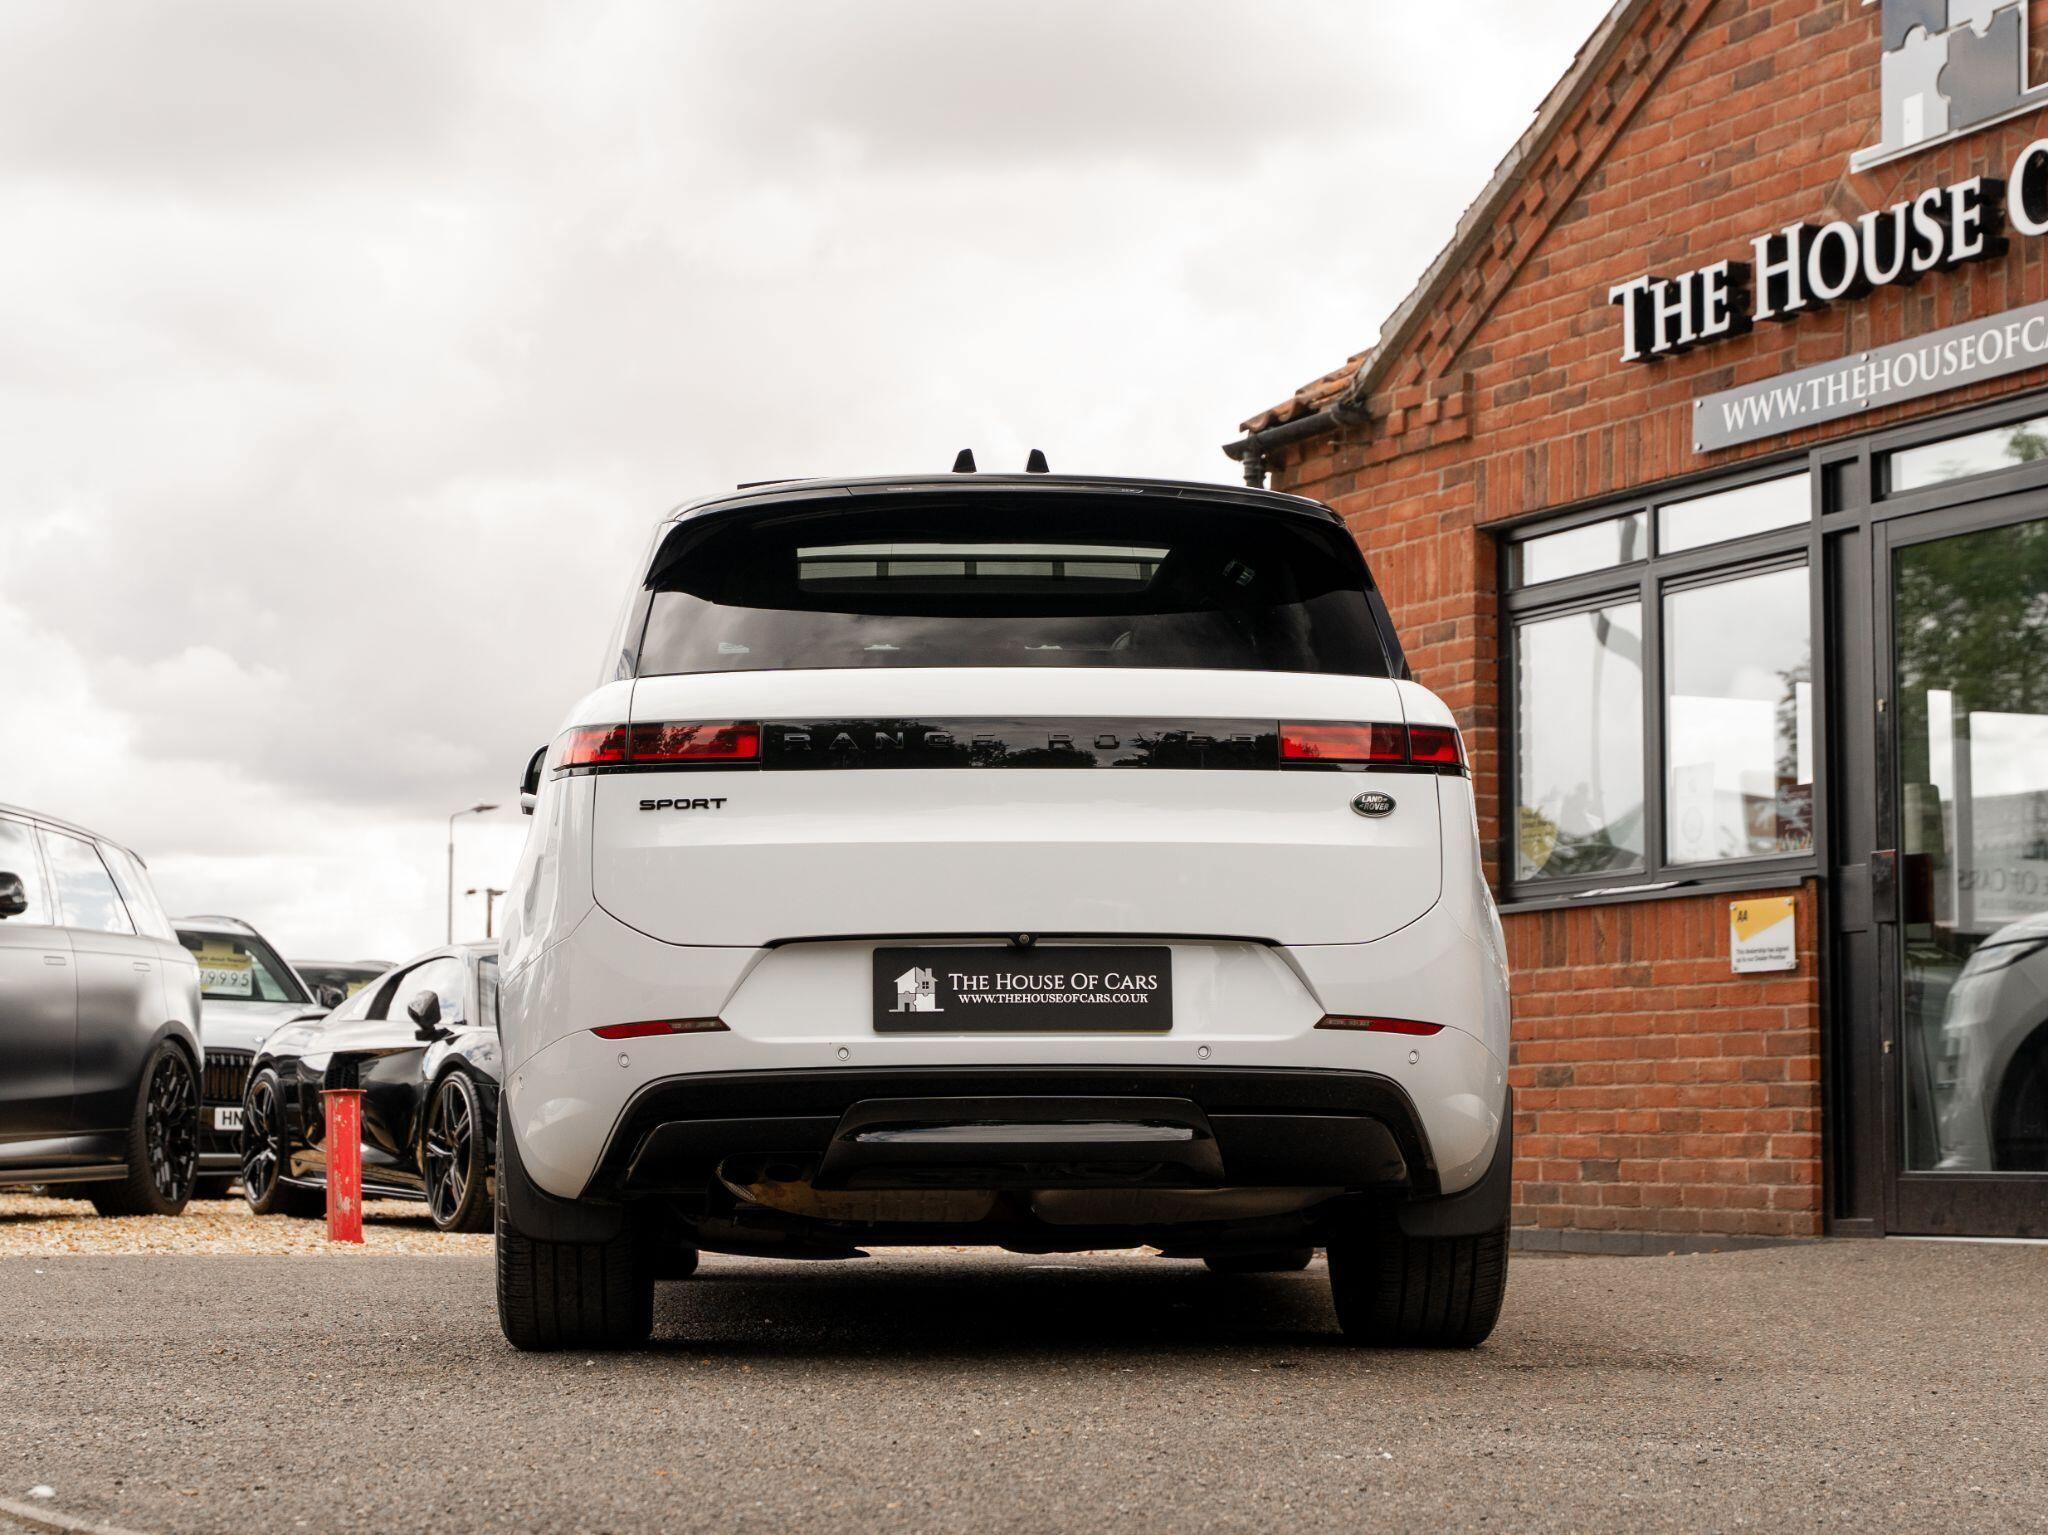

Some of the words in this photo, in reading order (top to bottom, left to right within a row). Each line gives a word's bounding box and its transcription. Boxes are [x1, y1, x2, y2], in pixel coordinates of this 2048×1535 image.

[1608, 259, 1732, 363] THE
[1749, 175, 1985, 322] HOUSE
[1722, 315, 2048, 433] WWW.THEHOUSEOFC
[783, 731, 997, 750] RANGE
[639, 797, 728, 811] SPORT
[1361, 795, 1383, 803] LAND
[1363, 802, 1389, 811] ROVER
[948, 973, 990, 991] THE
[995, 973, 1065, 990] HOUSE
[1070, 972, 1099, 990] OF
[1104, 972, 1158, 990] CARS
[958, 993, 1149, 1004] WWW.THEHOUSEOFCARS.CO.UK
